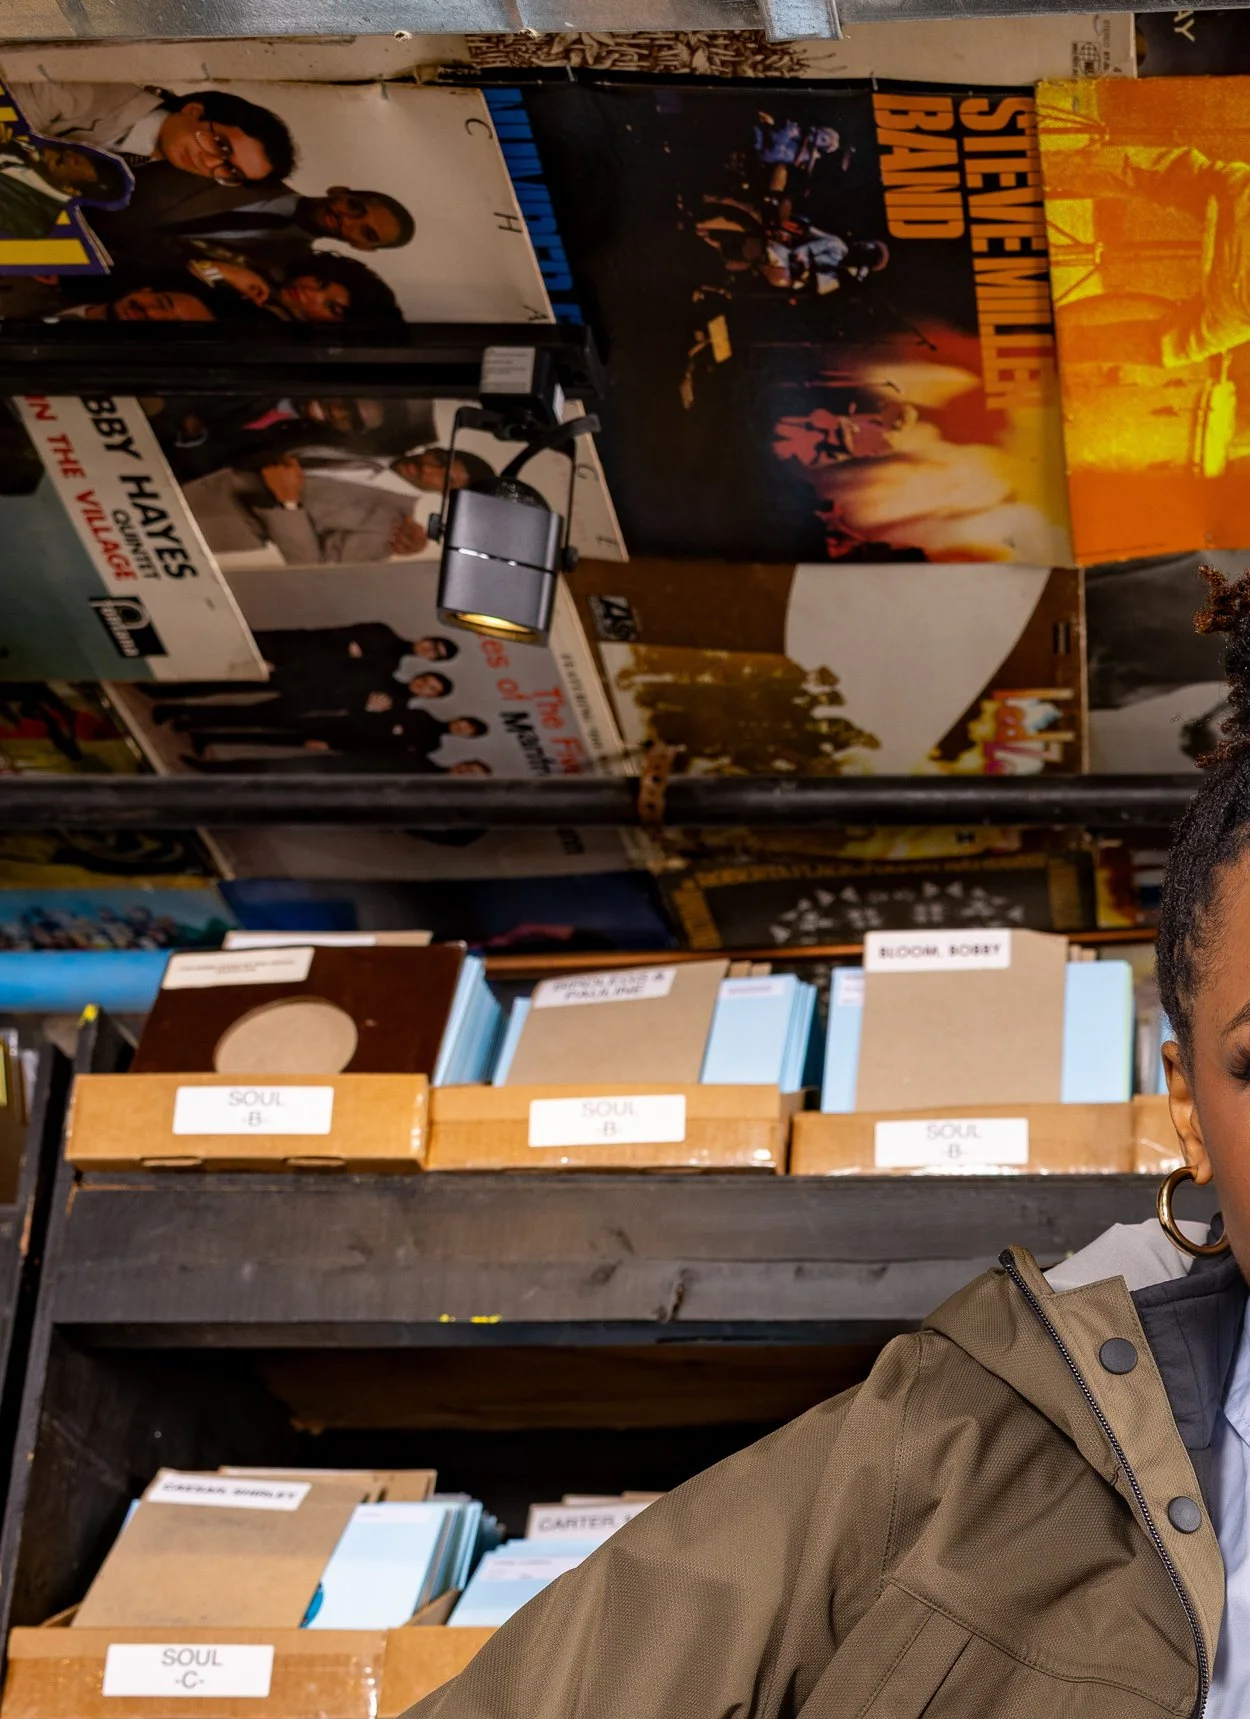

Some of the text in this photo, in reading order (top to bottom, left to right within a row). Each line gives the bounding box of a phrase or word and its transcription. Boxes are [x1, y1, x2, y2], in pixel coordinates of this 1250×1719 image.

[872, 93, 965, 240] BAND
[957, 97, 1055, 410] STEVE MILLER
[23, 395, 139, 584] IN THE VILLAGE
[119, 473, 200, 582] HAYES
[112, 508, 161, 582] QUINTET
[532, 686, 568, 730] The
[949, 943, 1003, 958] BOBBY
[227, 1089, 285, 1108] SOUL
[580, 1099, 638, 1119] SOUL
[926, 1122, 981, 1142] SOUL
[160, 1648, 224, 1668] SOUL
[174, 1670, 206, 1691] -C-
